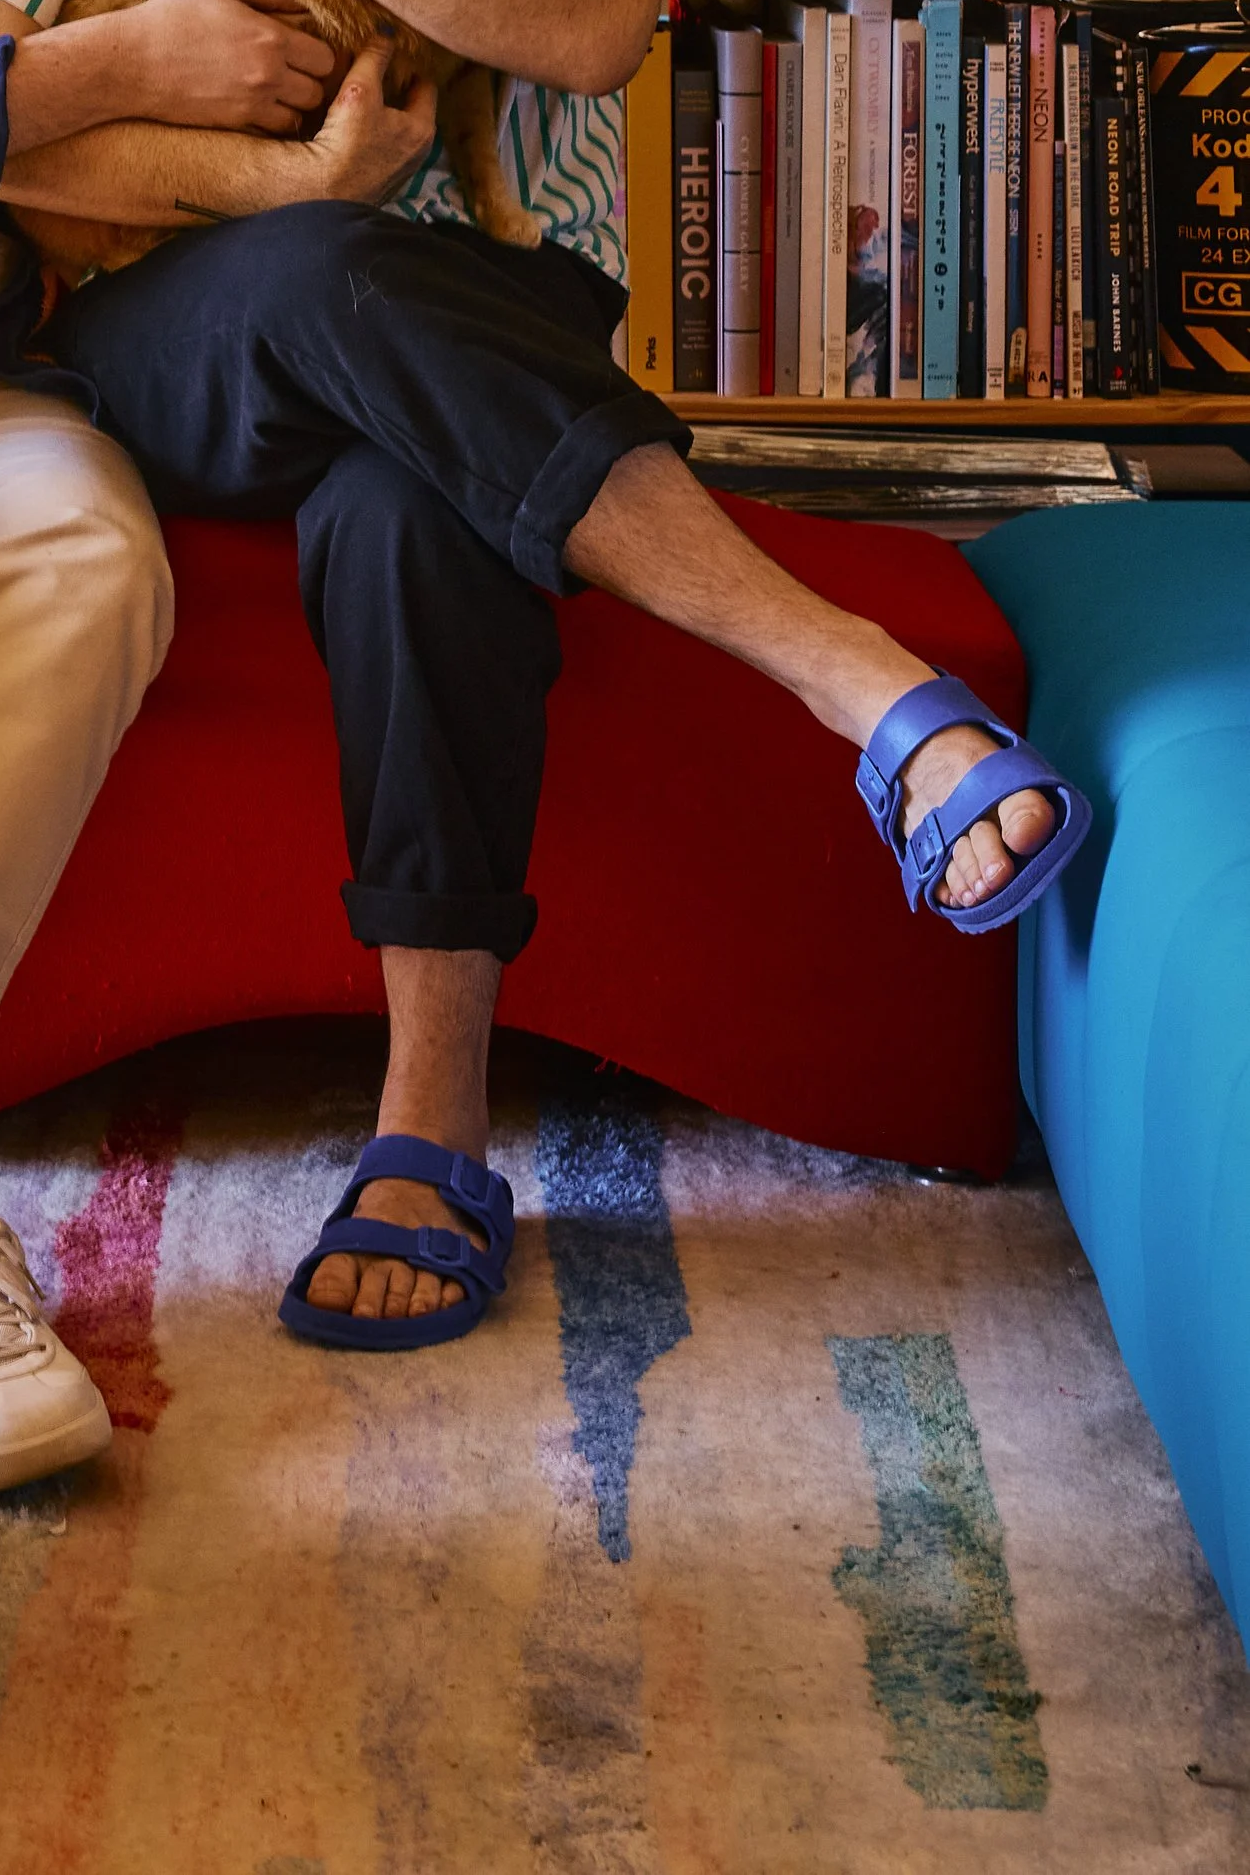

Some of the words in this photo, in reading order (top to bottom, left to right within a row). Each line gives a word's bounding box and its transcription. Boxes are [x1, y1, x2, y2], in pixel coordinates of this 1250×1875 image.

[1008, 20, 1022, 44] THE
[832, 52, 848, 86] Dan
[1008, 44, 1022, 76] NEW
[1068, 64, 1080, 90] NEON
[1134, 60, 1145, 86] NEW
[868, 58, 881, 134] TWOMBLY
[1008, 78, 1022, 99] LET
[831, 87, 848, 133] Flavin:
[960, 58, 982, 154] hyperwest
[1008, 102, 1022, 138] THERE
[1032, 88, 1049, 142] NEON
[1068, 90, 1080, 124] LOVERS
[1136, 87, 1146, 137] ORLEANS
[831, 140, 846, 150] A
[988, 98, 1005, 174] FREESTYLE
[1008, 140, 1021, 156] BE
[1068, 125, 1080, 150] GLOW
[1106, 118, 1120, 166] NEON
[902, 130, 918, 219] FOREST
[1069, 152, 1080, 163] IN
[1069, 166, 1080, 182] THE
[1007, 156, 1021, 198] NEON
[1107, 171, 1120, 216] ROAD
[1196, 165, 1243, 217] 4
[830, 156, 846, 255] Retrospective
[1070, 184, 1080, 208] DARK
[680, 146, 711, 300] HEROIC
[1008, 208, 1020, 236] STERN
[1070, 226, 1081, 244] LILI
[1108, 221, 1122, 256] TRIP
[1178, 224, 1212, 241] FILM
[1217, 226, 1250, 242] FOR
[738, 232, 750, 292] GALLERY
[1070, 245, 1082, 281] LAKICH
[1202, 246, 1224, 264] 24
[1110, 272, 1121, 305] JOHN
[1194, 280, 1242, 308] CG
[1111, 308, 1122, 352] BARNES
[645, 336, 658, 371] Parks
